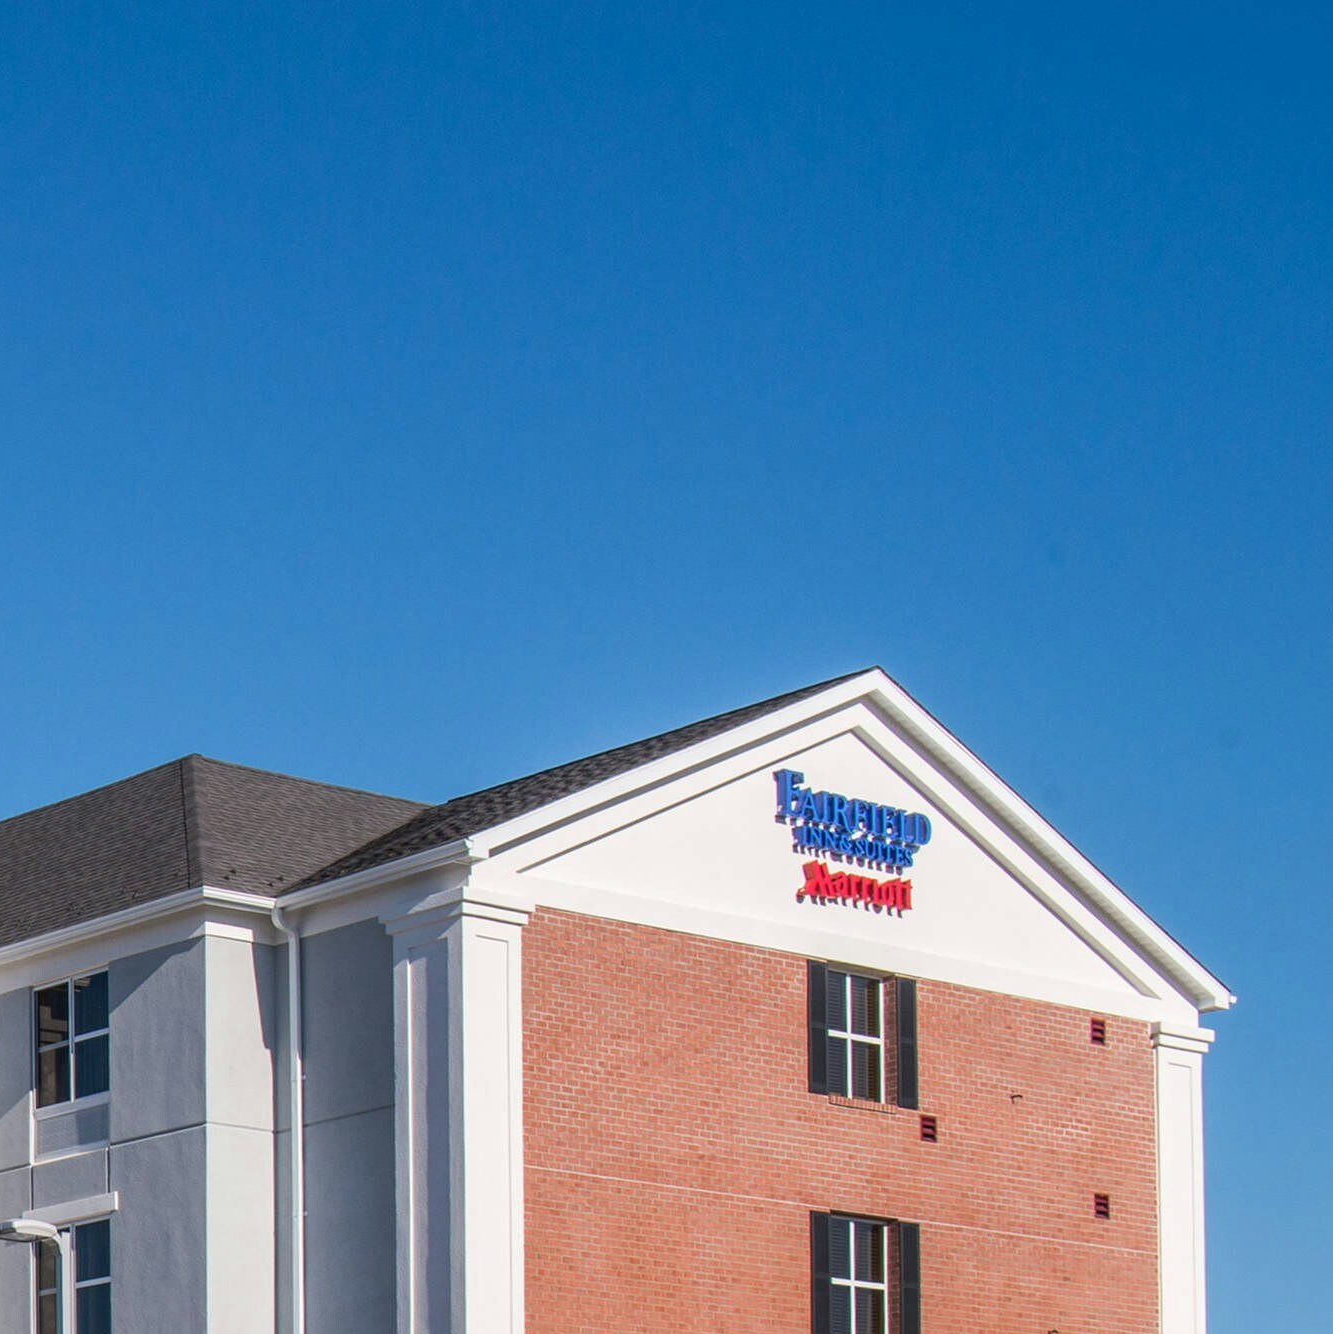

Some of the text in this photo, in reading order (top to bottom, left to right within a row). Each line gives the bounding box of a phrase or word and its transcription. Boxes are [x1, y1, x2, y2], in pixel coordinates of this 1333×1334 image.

[773, 768, 932, 846] FAIRFIELD
[792, 824, 838, 851] INN
[853, 838, 914, 868] SUITES
[796, 859, 913, 910] Marriott
